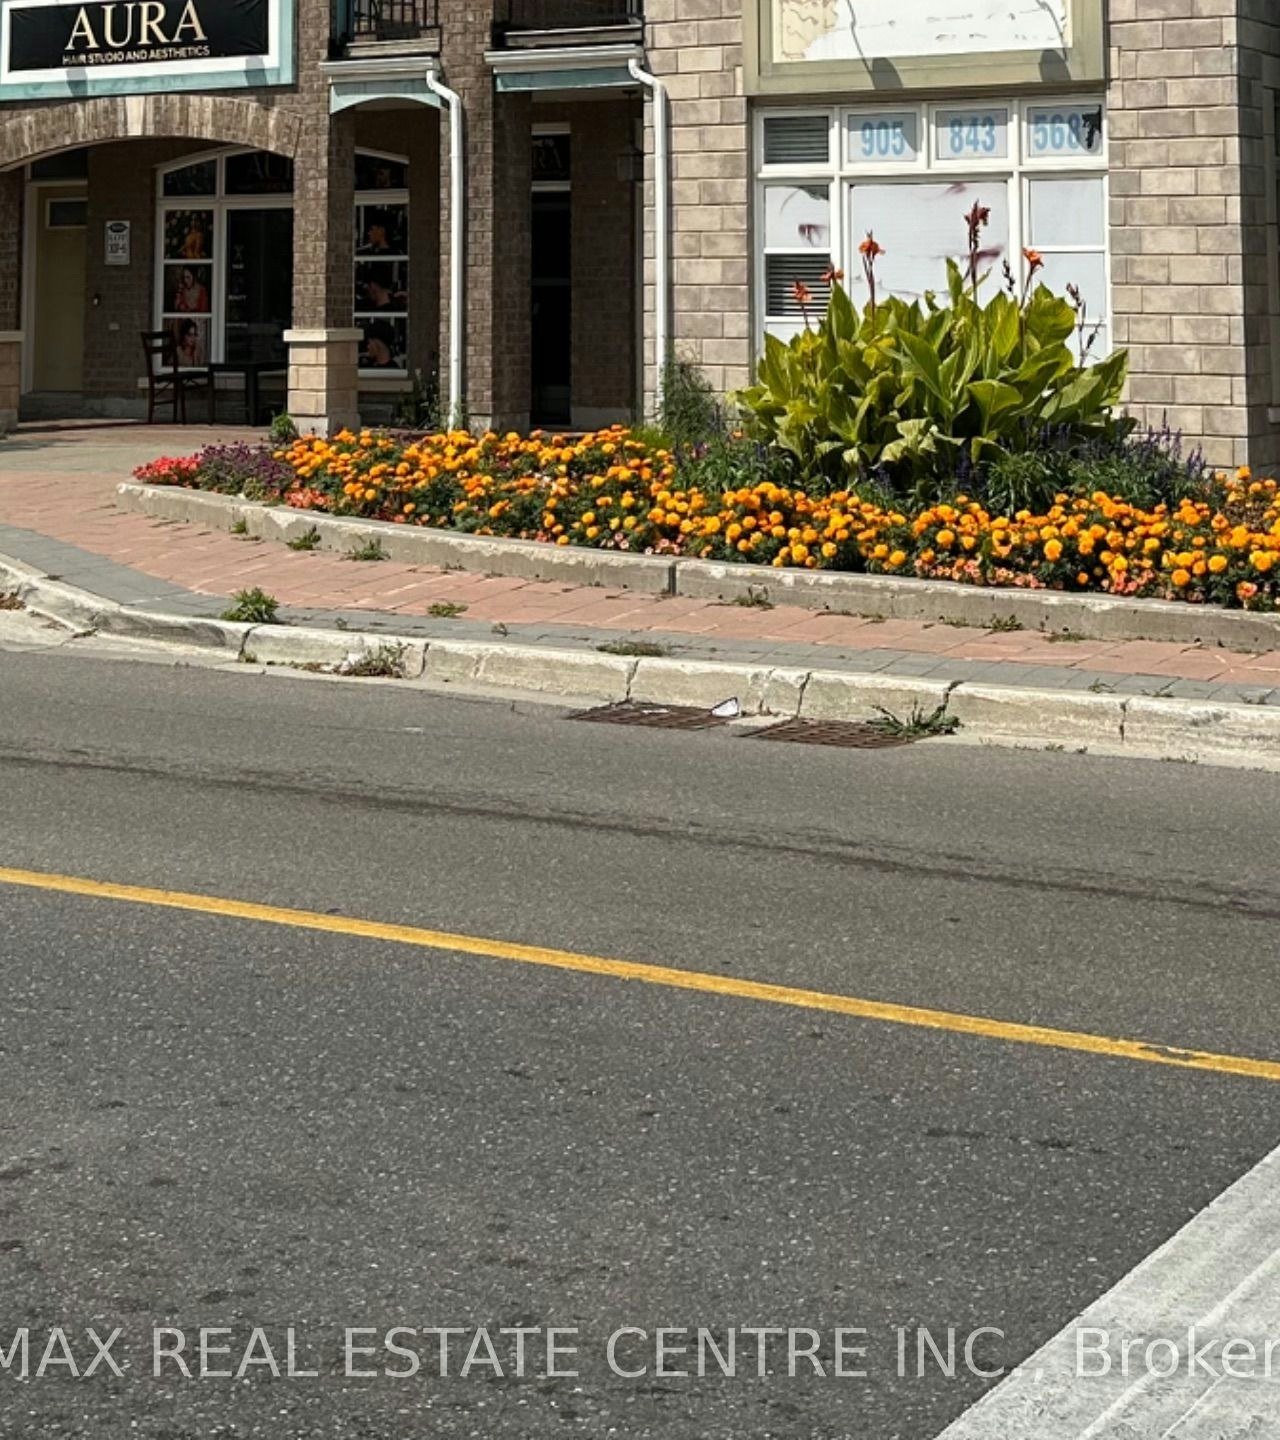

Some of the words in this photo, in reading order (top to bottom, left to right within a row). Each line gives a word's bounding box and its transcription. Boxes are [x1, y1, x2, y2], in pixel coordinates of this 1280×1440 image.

[62, 53, 86, 66] HAIR
[88, 51, 124, 64] STUDIO
[125, 48, 148, 62] AND
[149, 45, 211, 60] AESTHETICS
[861, 120, 905, 157] 905
[950, 115, 996, 153] 843
